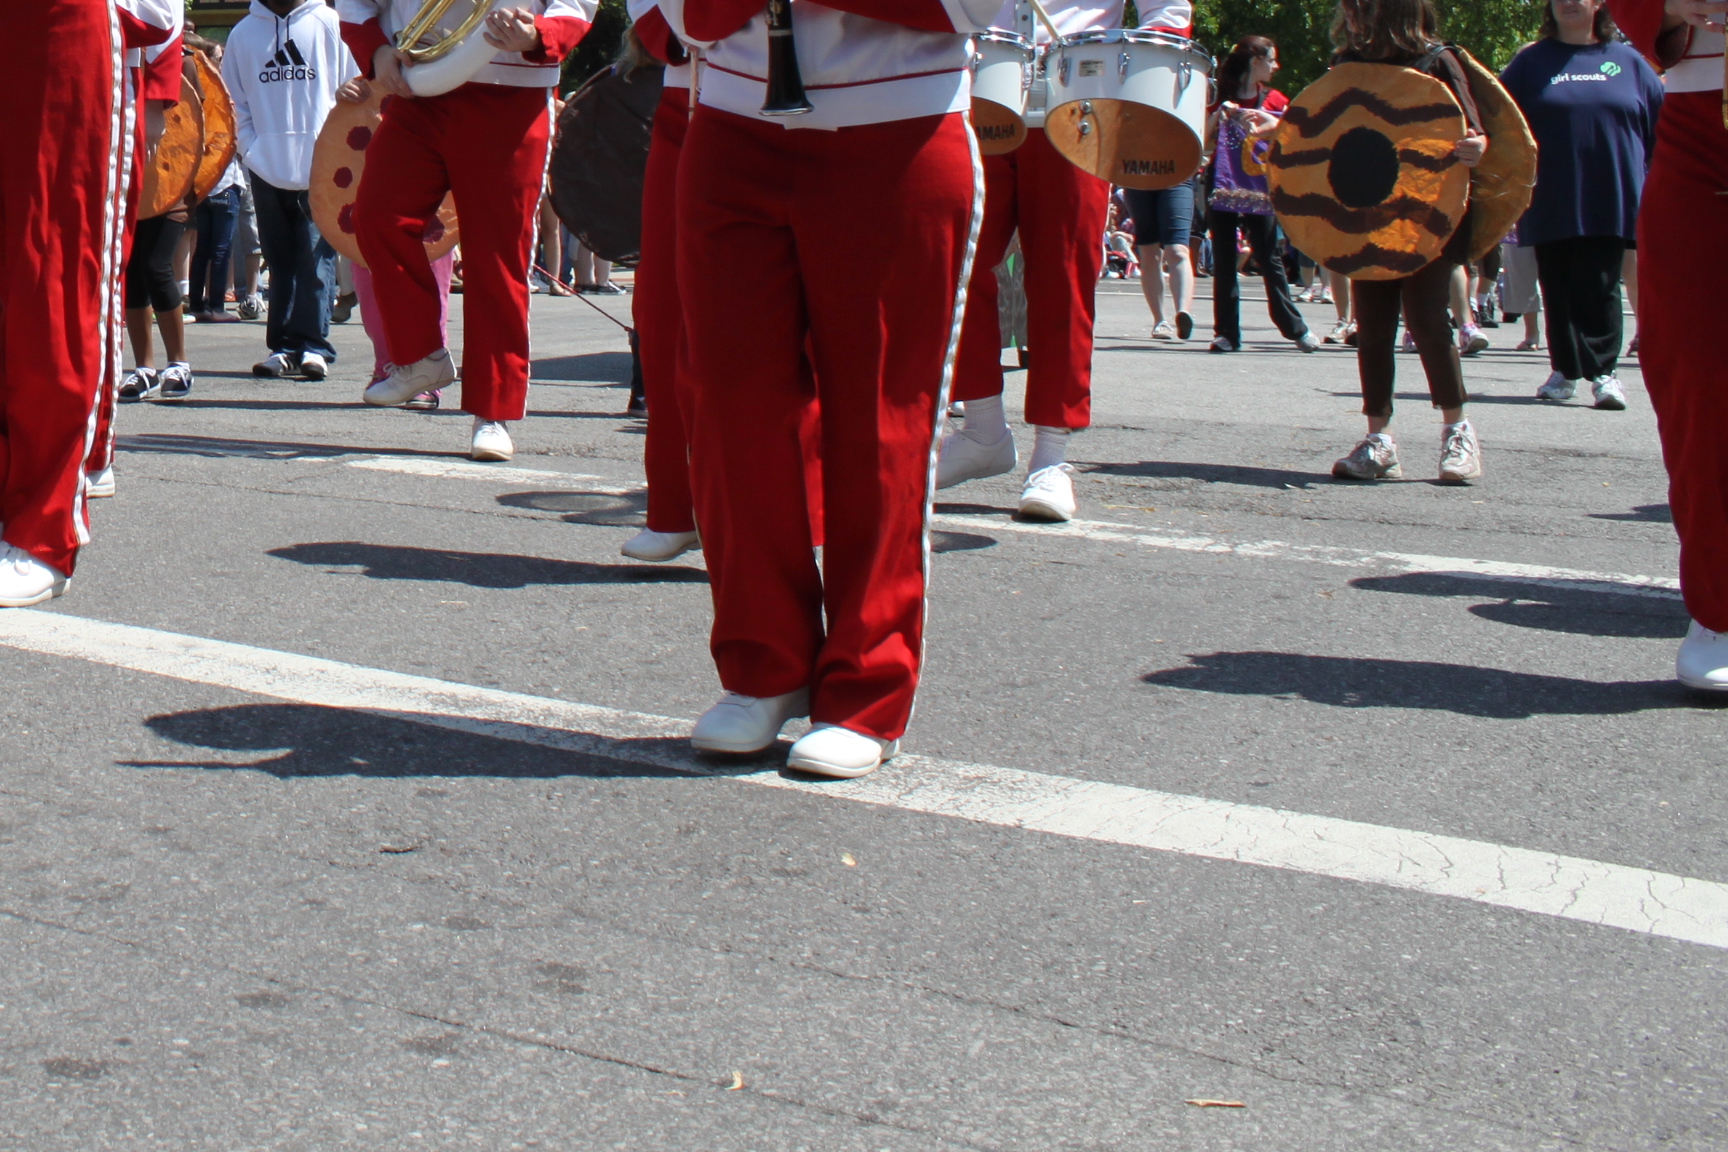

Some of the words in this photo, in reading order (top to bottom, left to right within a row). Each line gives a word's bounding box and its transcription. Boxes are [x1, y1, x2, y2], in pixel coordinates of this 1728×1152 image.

[259, 66, 316, 83] adidas
[1551, 73, 1569, 85] girl
[1571, 73, 1607, 81] scouts
[976, 123, 1016, 140] AMAHA
[1122, 159, 1176, 174] YAMAHA
